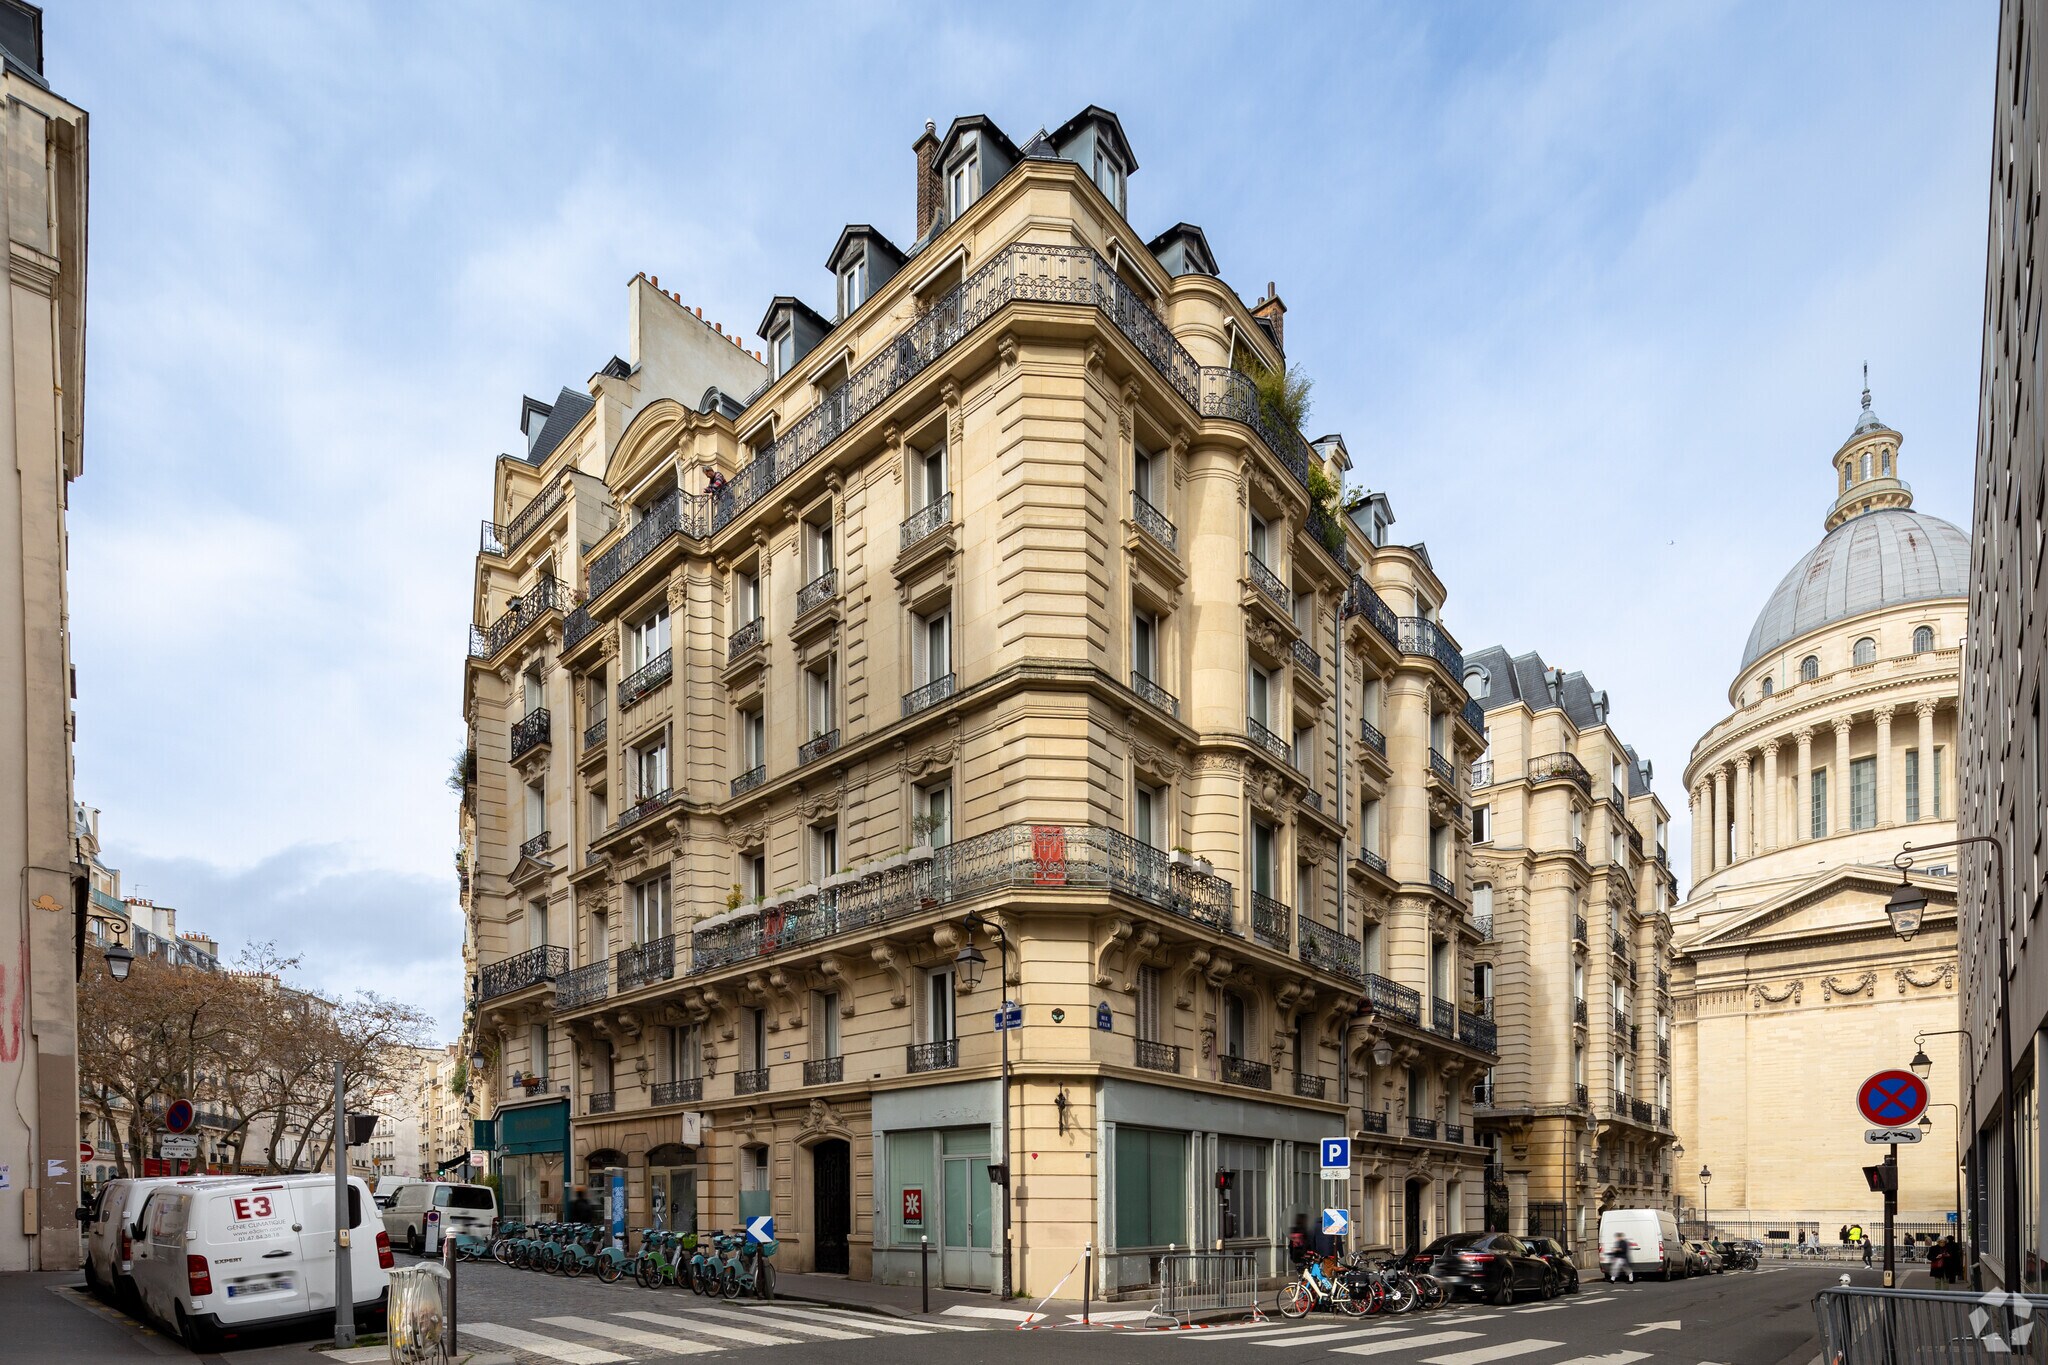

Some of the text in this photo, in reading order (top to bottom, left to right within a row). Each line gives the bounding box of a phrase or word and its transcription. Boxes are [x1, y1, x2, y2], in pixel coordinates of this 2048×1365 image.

[1329, 1143, 1342, 1163] P
[233, 1196, 272, 1220] E3
[247, 1219, 287, 1229] CLIMATIQUE
[214, 1257, 243, 1265] EXPERT
